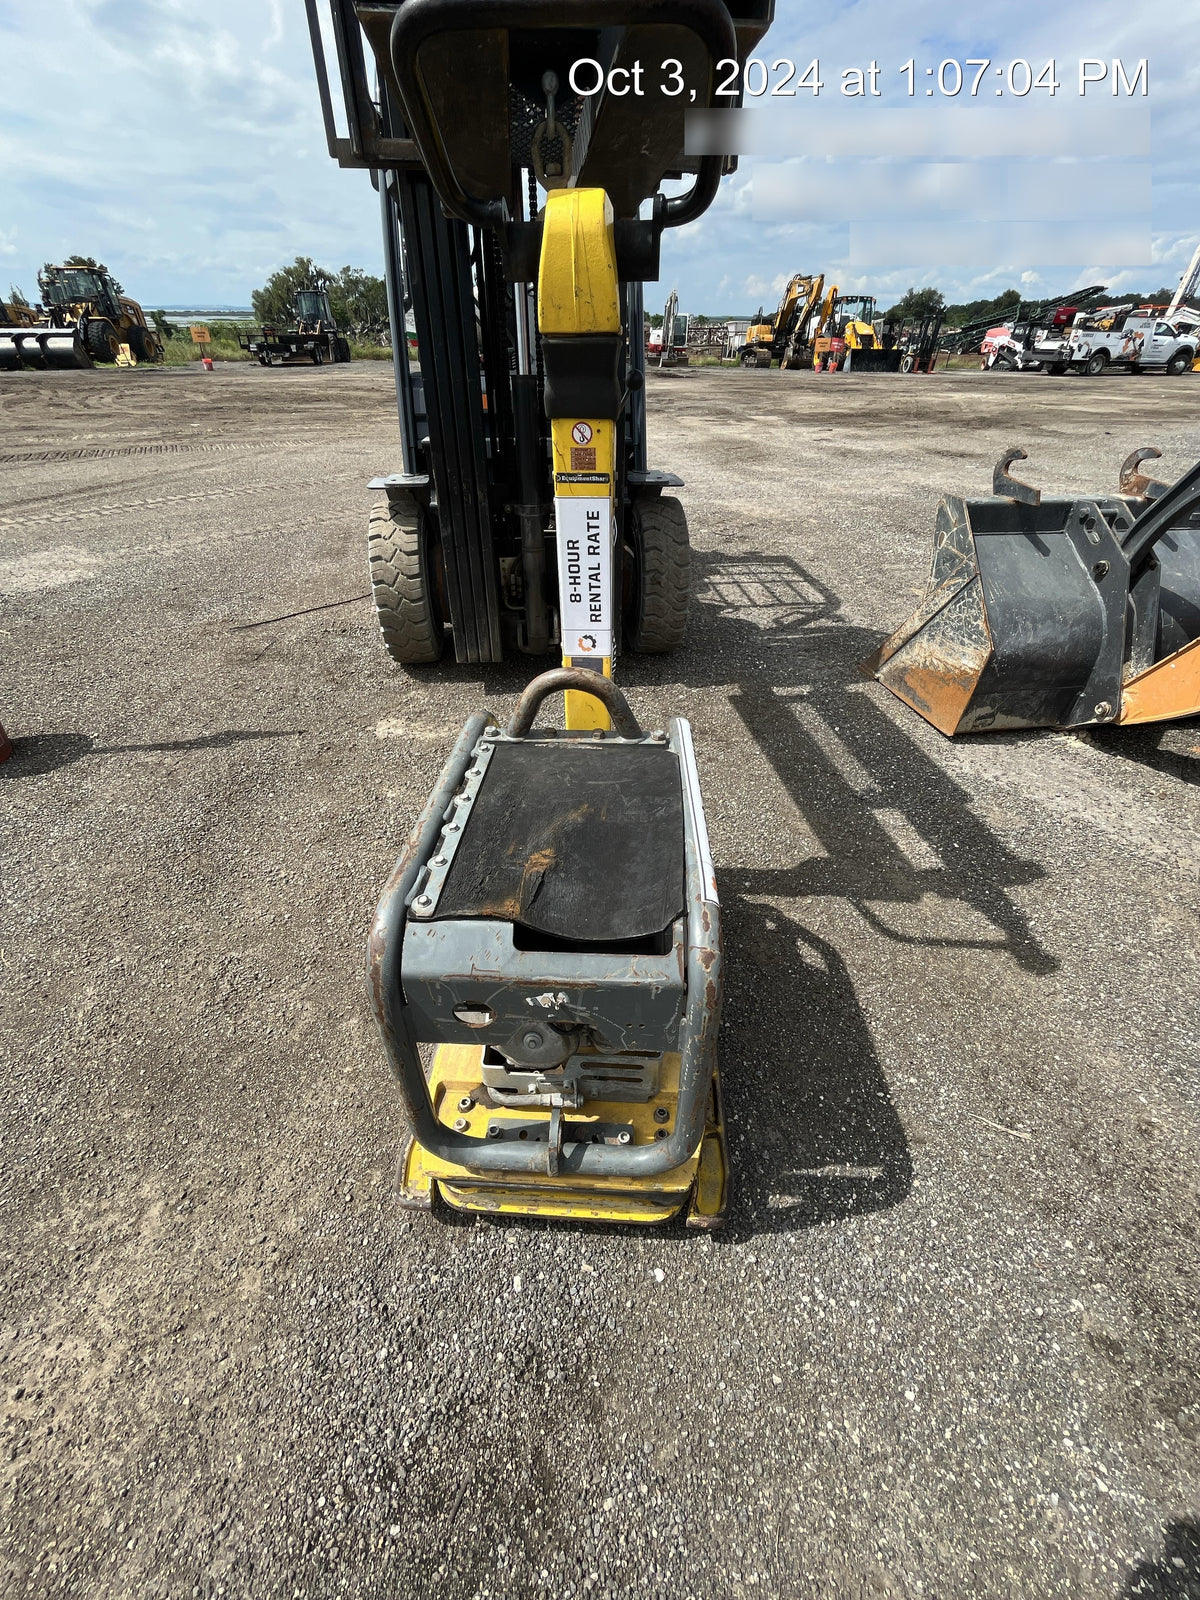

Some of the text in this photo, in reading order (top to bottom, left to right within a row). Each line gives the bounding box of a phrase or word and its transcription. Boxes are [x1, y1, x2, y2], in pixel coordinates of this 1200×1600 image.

[567, 539, 582, 603] 8-HOUR
[586, 511, 602, 623] RENTAL RATE
